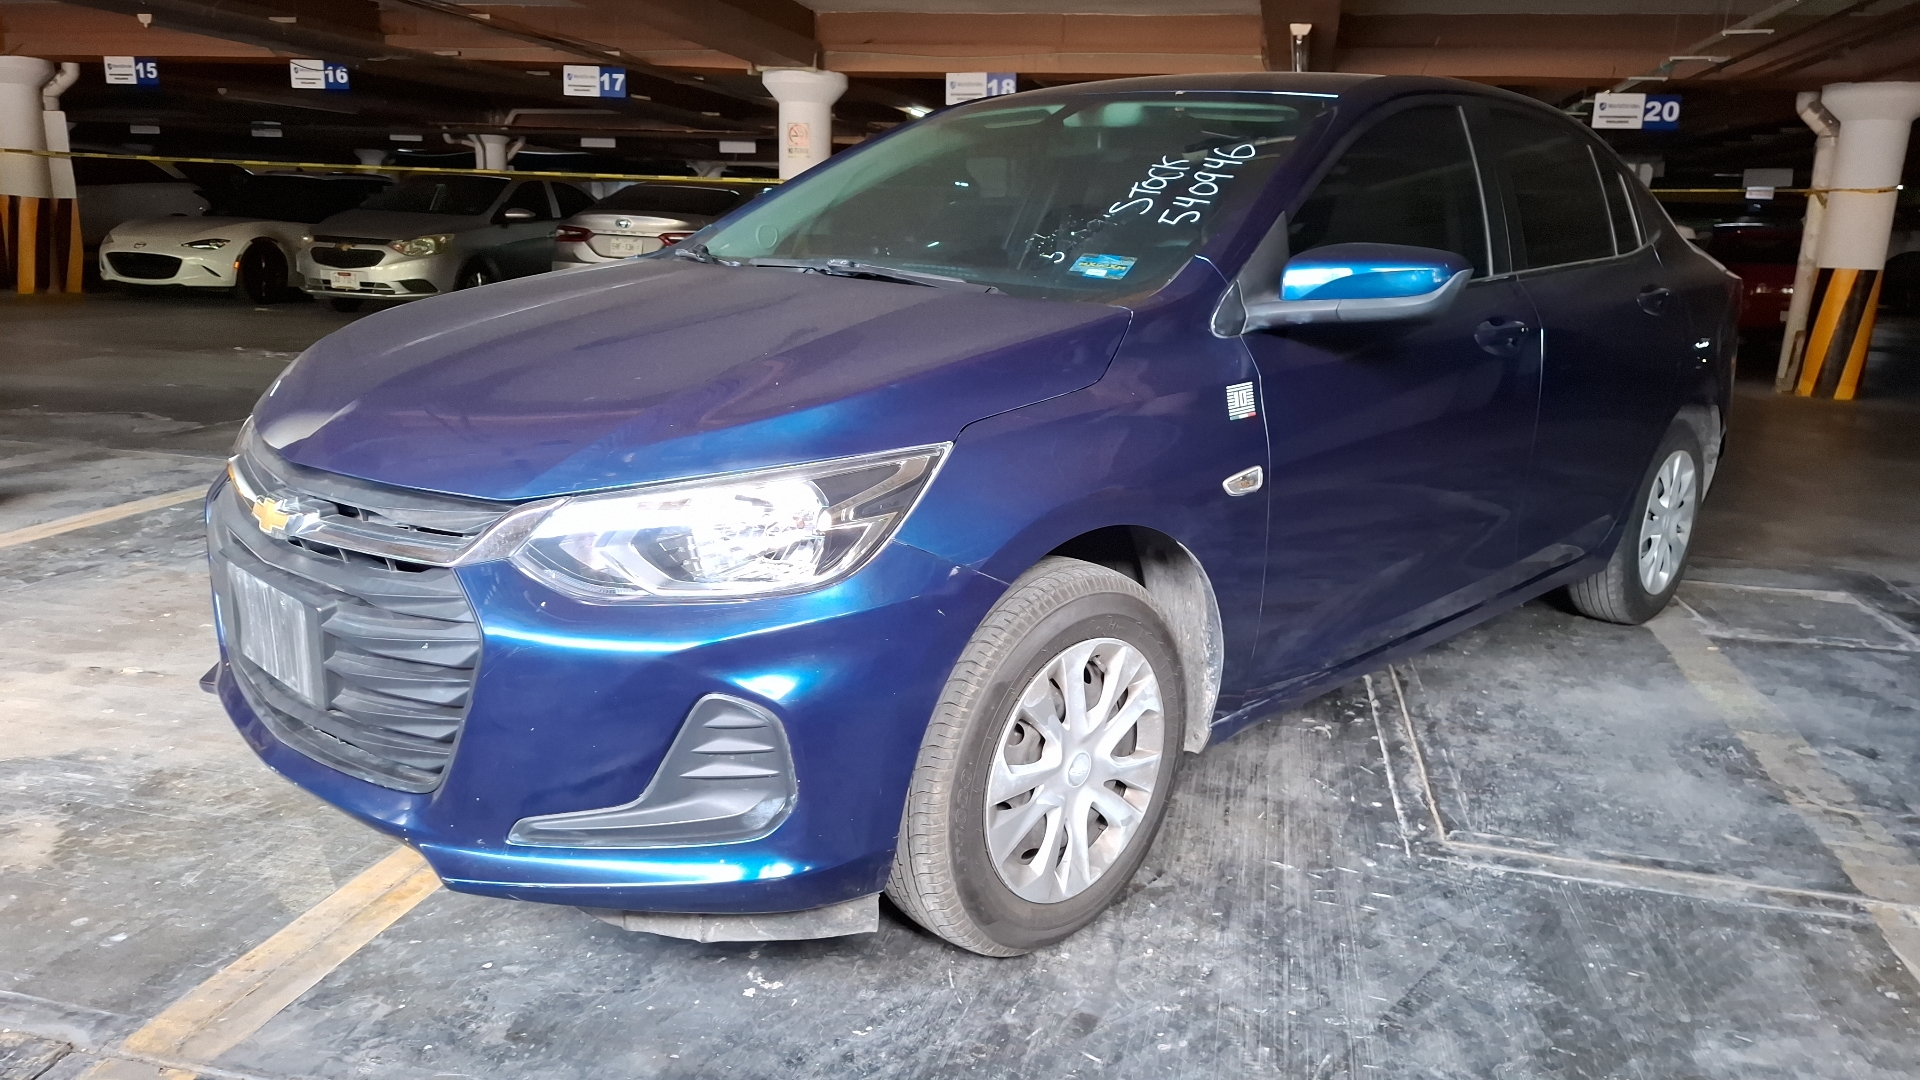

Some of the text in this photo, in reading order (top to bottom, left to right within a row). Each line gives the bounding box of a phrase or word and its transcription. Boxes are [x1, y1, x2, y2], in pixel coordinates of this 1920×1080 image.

[136, 62, 158, 79] 15
[324, 66, 349, 84] 16
[600, 72, 626, 92] 17
[987, 79, 1016, 96] 18
[1644, 101, 1680, 122] 20
[1108, 154, 1191, 216] STOCK
[1157, 143, 1257, 226] 540946
